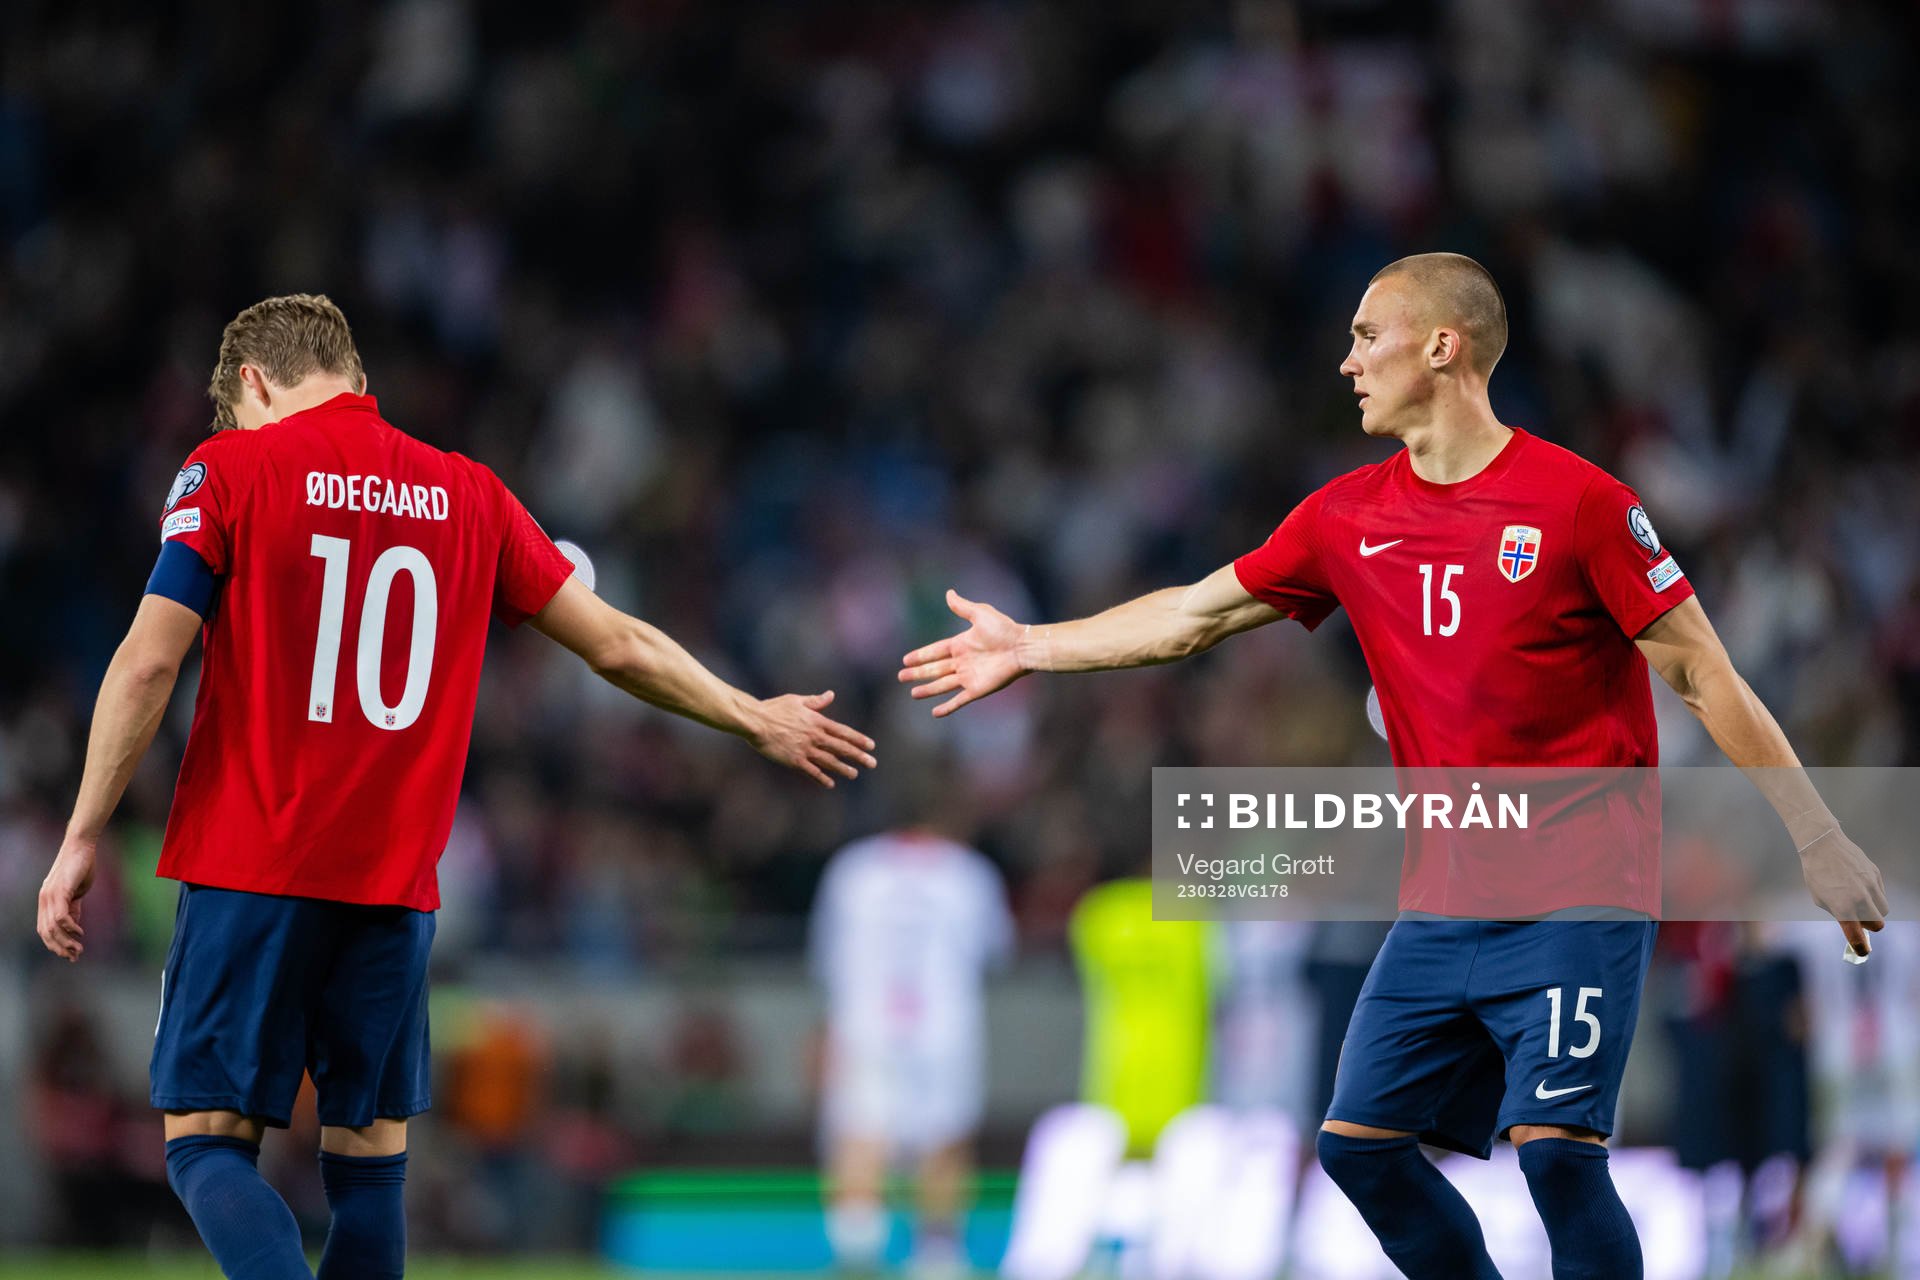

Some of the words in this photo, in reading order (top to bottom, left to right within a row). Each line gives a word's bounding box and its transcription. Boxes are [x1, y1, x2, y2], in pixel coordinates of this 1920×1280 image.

[306, 471, 449, 521] ØDEGAARD
[307, 533, 438, 731] 10
[1418, 564, 1464, 637] 15
[1546, 986, 1603, 1058] 15
